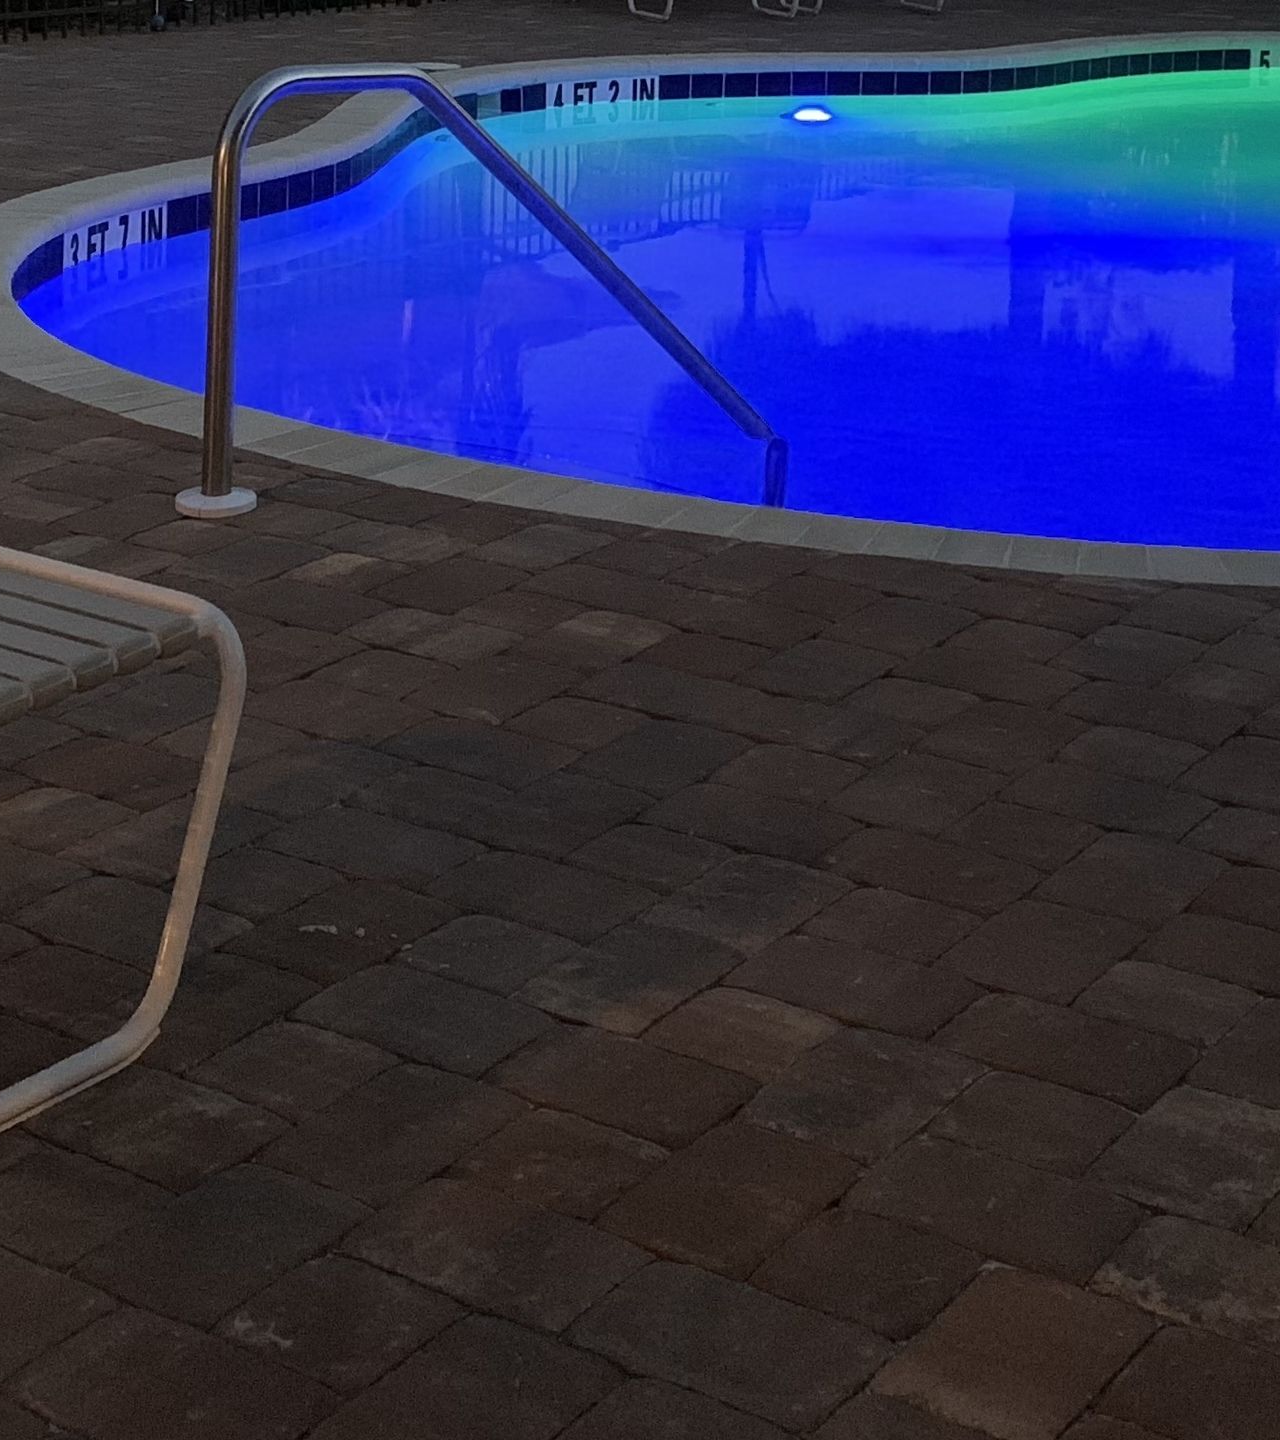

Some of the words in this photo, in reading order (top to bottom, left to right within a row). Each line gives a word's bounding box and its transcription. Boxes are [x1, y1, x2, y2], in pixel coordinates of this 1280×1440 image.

[1260, 50, 1270, 69] 5
[553, 83, 564, 107] 4
[573, 81, 597, 106] FT
[608, 79, 620, 103] 2
[632, 78, 655, 102] IN
[86, 221, 109, 262] FT
[118, 214, 129, 250] 7
[141, 207, 163, 244] IN
